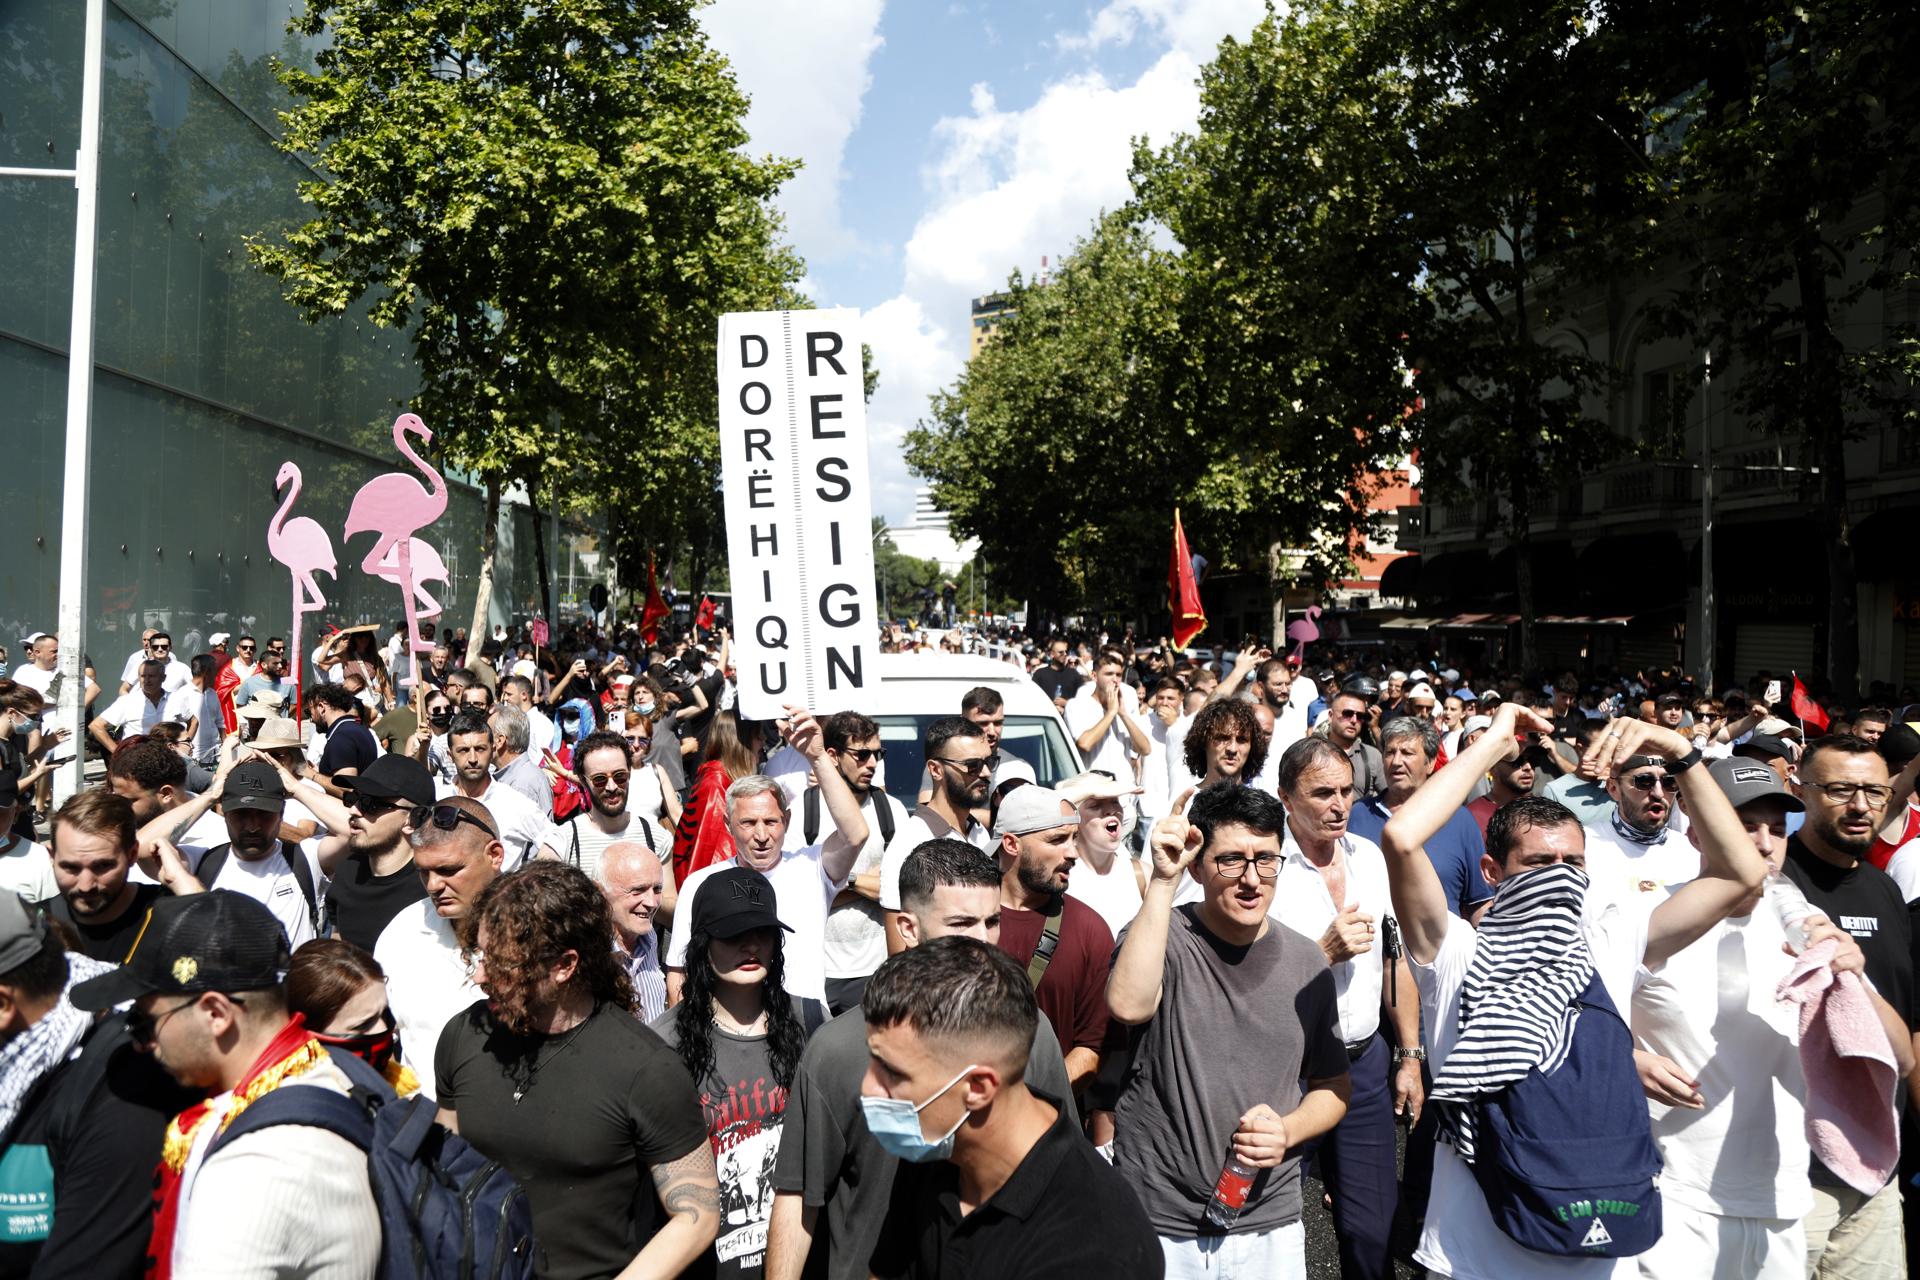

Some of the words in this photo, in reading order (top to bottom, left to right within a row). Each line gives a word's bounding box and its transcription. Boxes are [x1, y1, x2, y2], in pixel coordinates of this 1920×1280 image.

[739, 334, 788, 695] DORËHIQU
[806, 330, 863, 690] RESIGN
[1781, 593, 1814, 606] GOLD
[728, 879, 765, 906] NY
[1839, 915, 1879, 931] IDENTITY
[699, 1077, 790, 1137] Califo
[740, 1253, 762, 1269] MARCH
